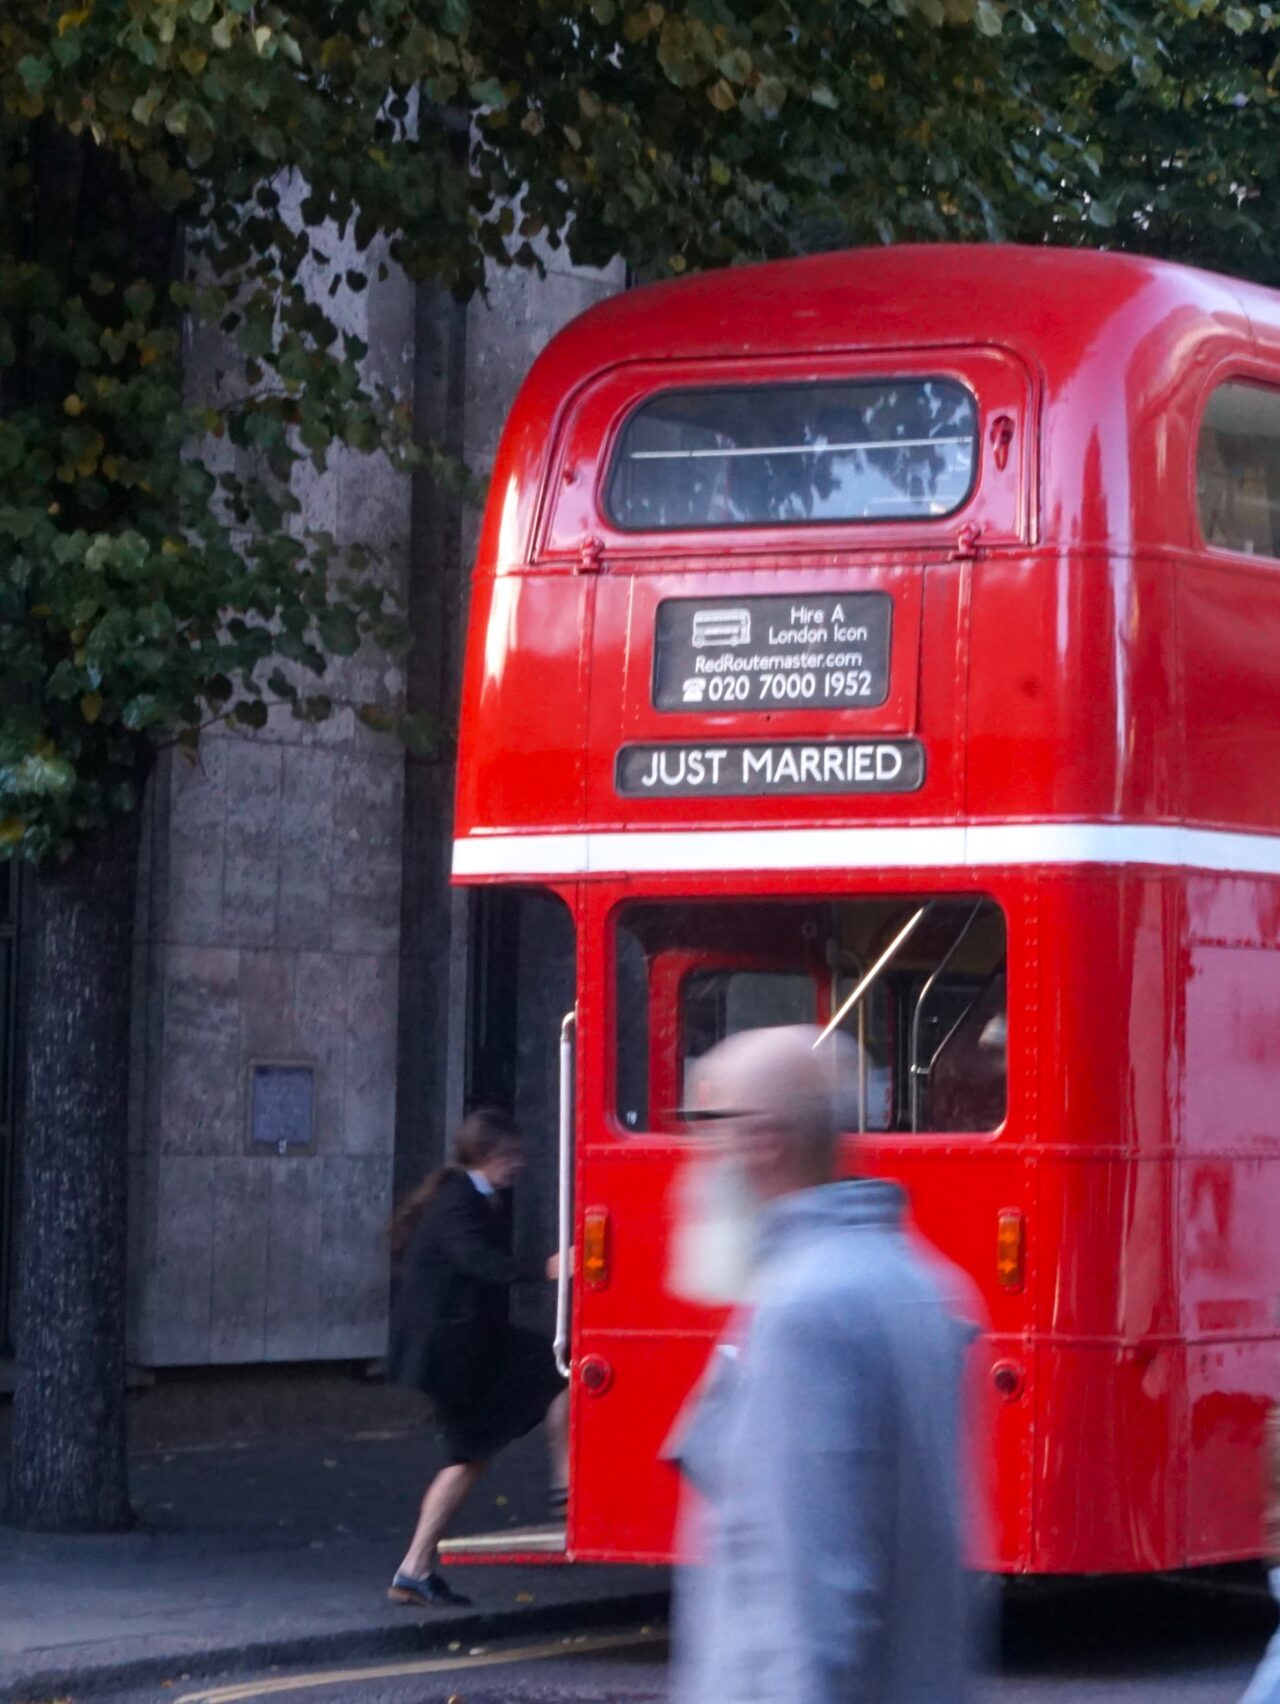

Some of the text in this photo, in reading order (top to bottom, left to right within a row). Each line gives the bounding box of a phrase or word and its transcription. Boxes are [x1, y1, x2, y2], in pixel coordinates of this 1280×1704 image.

[790, 603, 844, 624] Hire A
[769, 624, 867, 645] London Icon
[695, 652, 862, 673] RedRoutemaster.com
[708, 671, 871, 701] 020 7000 1952
[641, 745, 902, 786] JUST MARRIED
